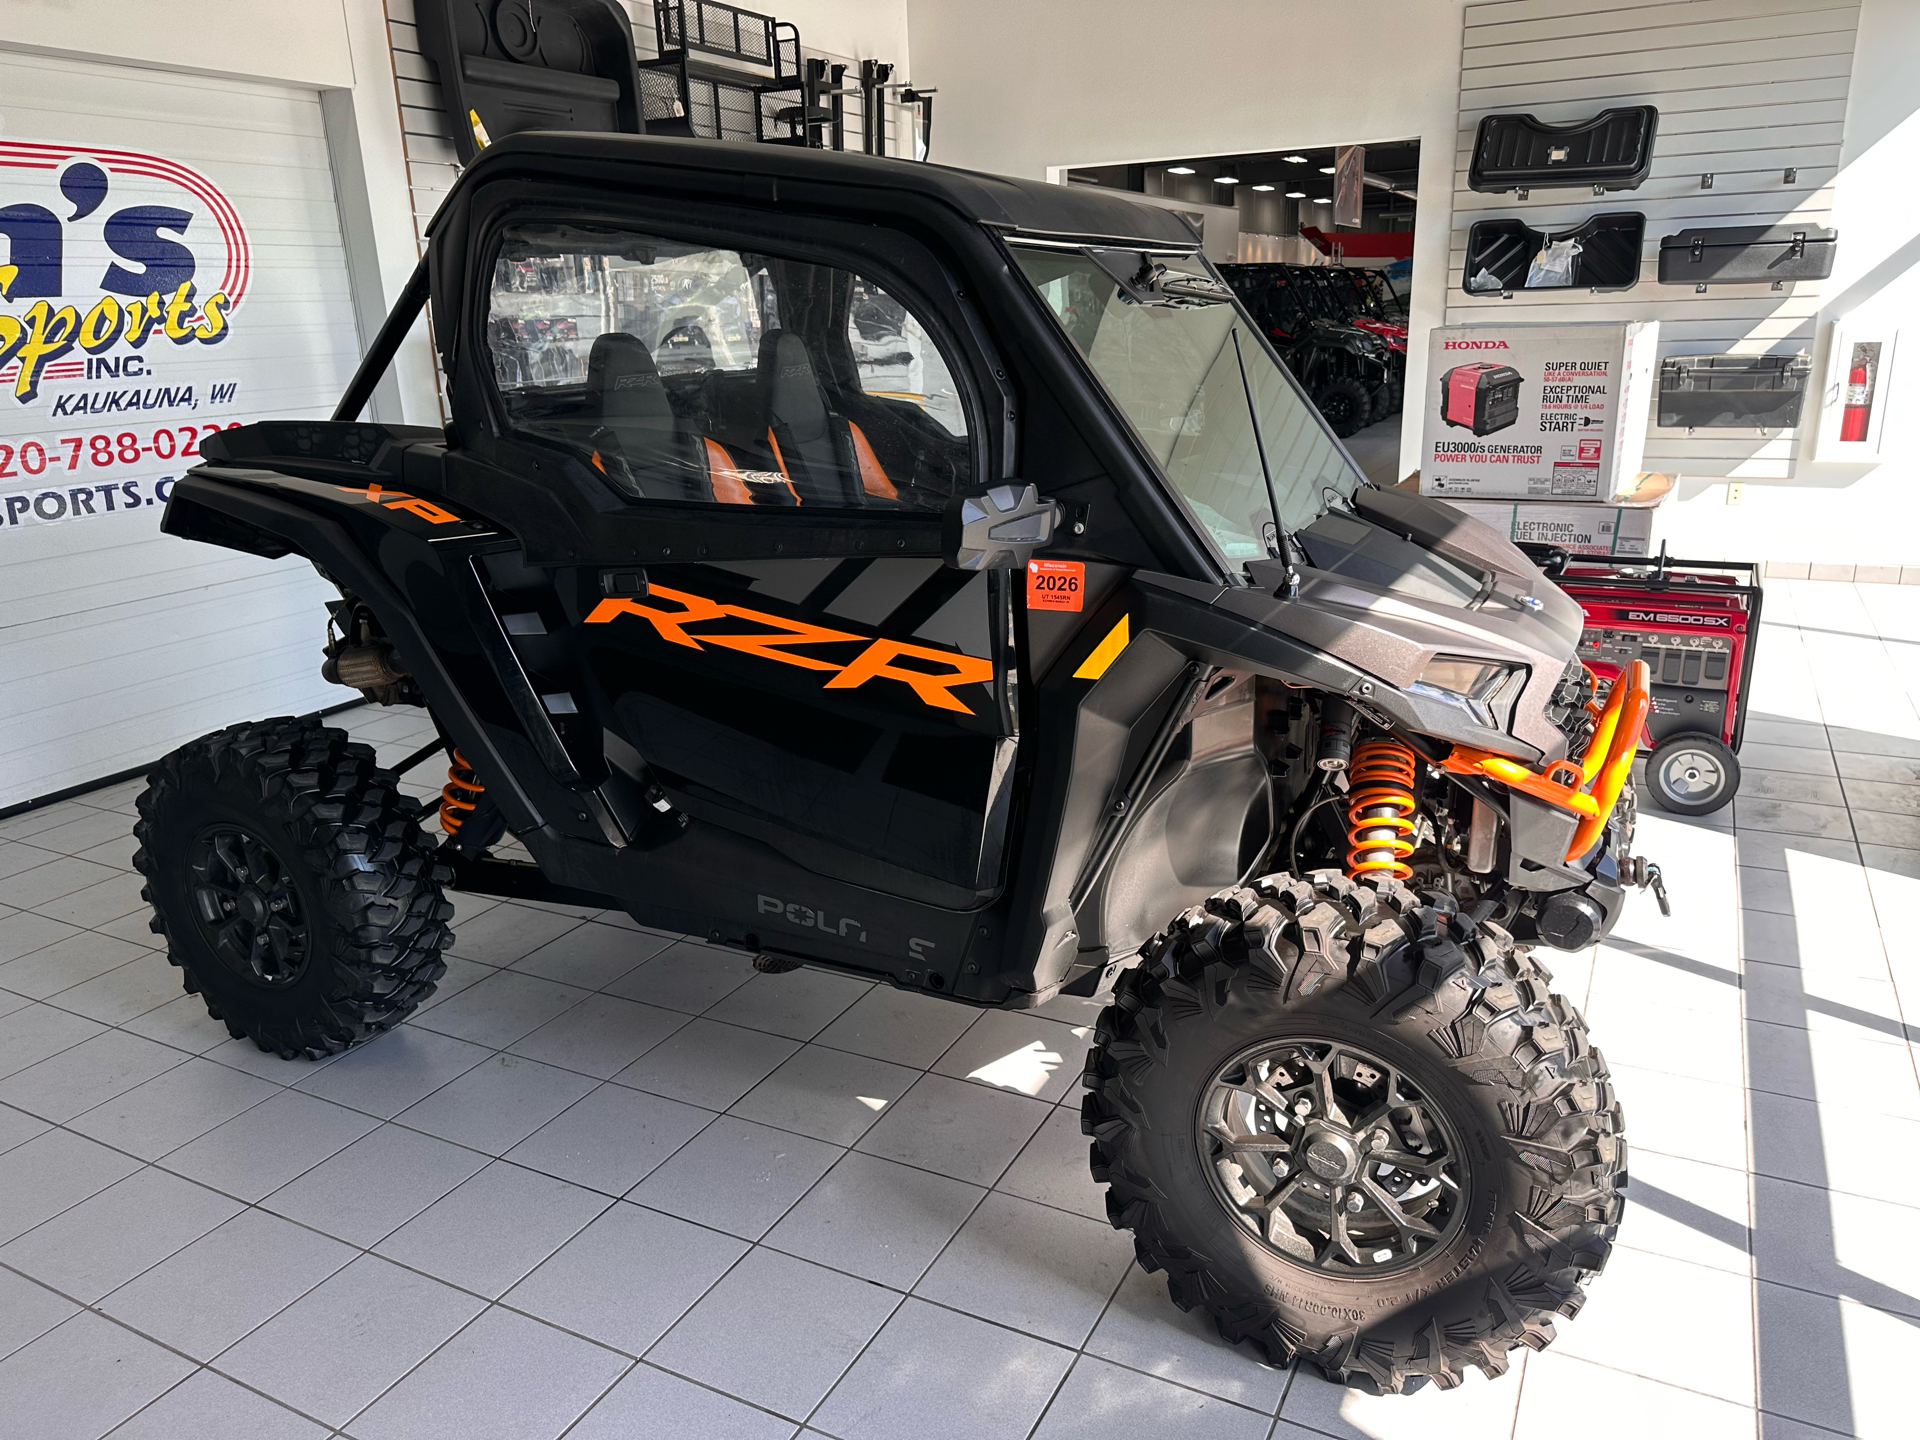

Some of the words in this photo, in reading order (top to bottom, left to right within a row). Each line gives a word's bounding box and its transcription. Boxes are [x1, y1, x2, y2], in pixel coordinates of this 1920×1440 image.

[1443, 340, 1510, 350] HONDA
[86, 355, 152, 380] INC.
[780, 363, 812, 379] RZR
[1544, 361, 1577, 371] SUPER
[1579, 361, 1609, 371] QUIET
[614, 373, 660, 391] RZR
[1542, 385, 1608, 395] EXCEPTIONAL
[51, 386, 199, 417] KAUKAUNA,
[209, 382, 238, 404] WI
[1542, 394, 1563, 404] RUN
[1565, 394, 1590, 404] TIME
[1540, 413, 1578, 421] ELECTRIC
[1539, 421, 1577, 432] START
[0, 422, 243, 478] 20-788-02
[1434, 441, 1486, 454] EU3000is
[1487, 445, 1543, 455] GENERATOR
[1433, 453, 1467, 463] POWER
[1469, 454, 1488, 463] YOU
[1489, 454, 1509, 464] CAN
[1511, 455, 1542, 464] TRUST
[0, 476, 175, 526] PORTS.C
[333, 483, 462, 525] XP
[1537, 532, 1592, 544] INJECTION
[1035, 574, 1079, 592] 2026
[584, 582, 994, 715] RZR
[757, 894, 936, 963] POLAS
